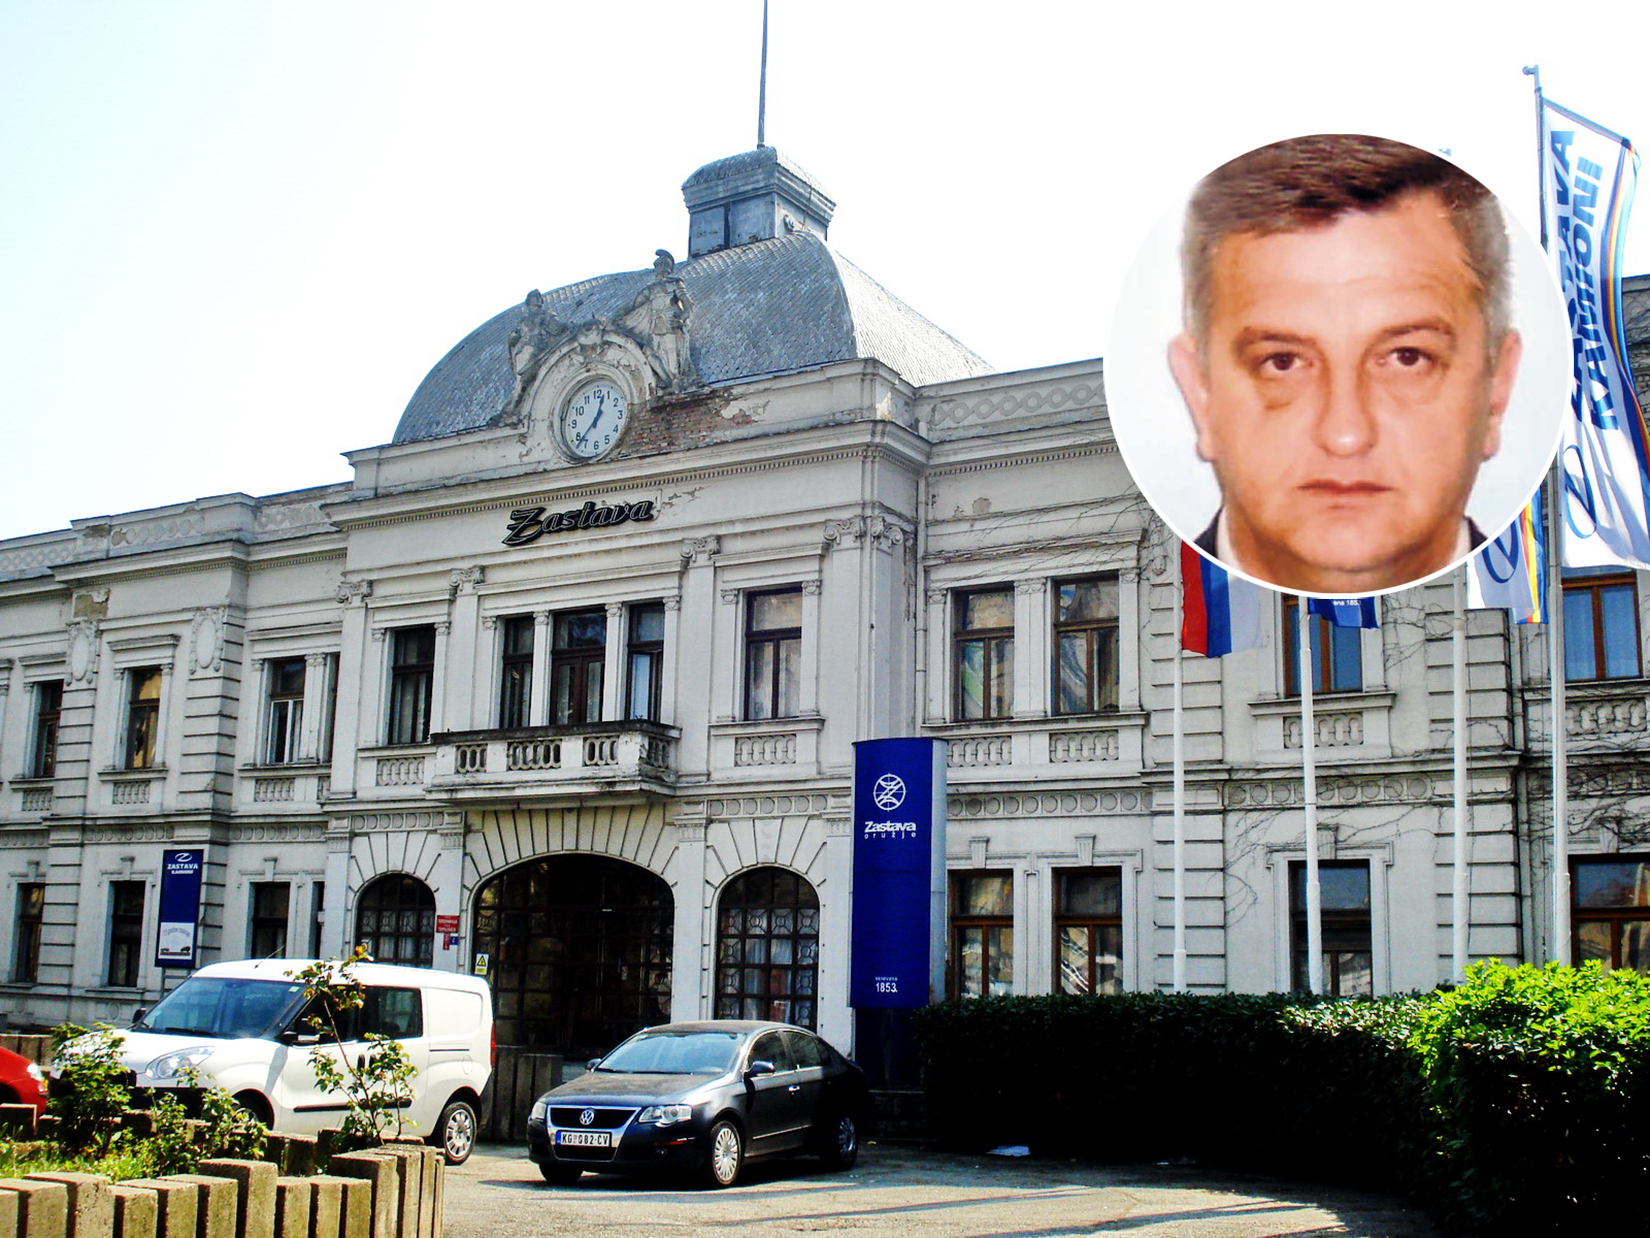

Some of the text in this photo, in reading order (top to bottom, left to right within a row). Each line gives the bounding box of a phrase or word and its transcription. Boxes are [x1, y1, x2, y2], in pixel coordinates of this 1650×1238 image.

[1573, 156, 1618, 430] KAMIONI
[593, 389, 603, 399] 12
[584, 395, 590, 405] 11
[613, 397, 619, 407] 2
[575, 406, 584, 416] 10
[617, 410, 623, 419] 3
[571, 419, 577, 429] 9
[613, 424, 619, 433] 4
[575, 432, 581, 441] 8
[604, 435, 610, 445] 5
[581, 439, 588, 448] 7
[593, 441, 599, 450] 6
[501, 500, 654, 546] Zastava
[864, 820, 917, 833] Zastava
[876, 982, 898, 993] 1853.
